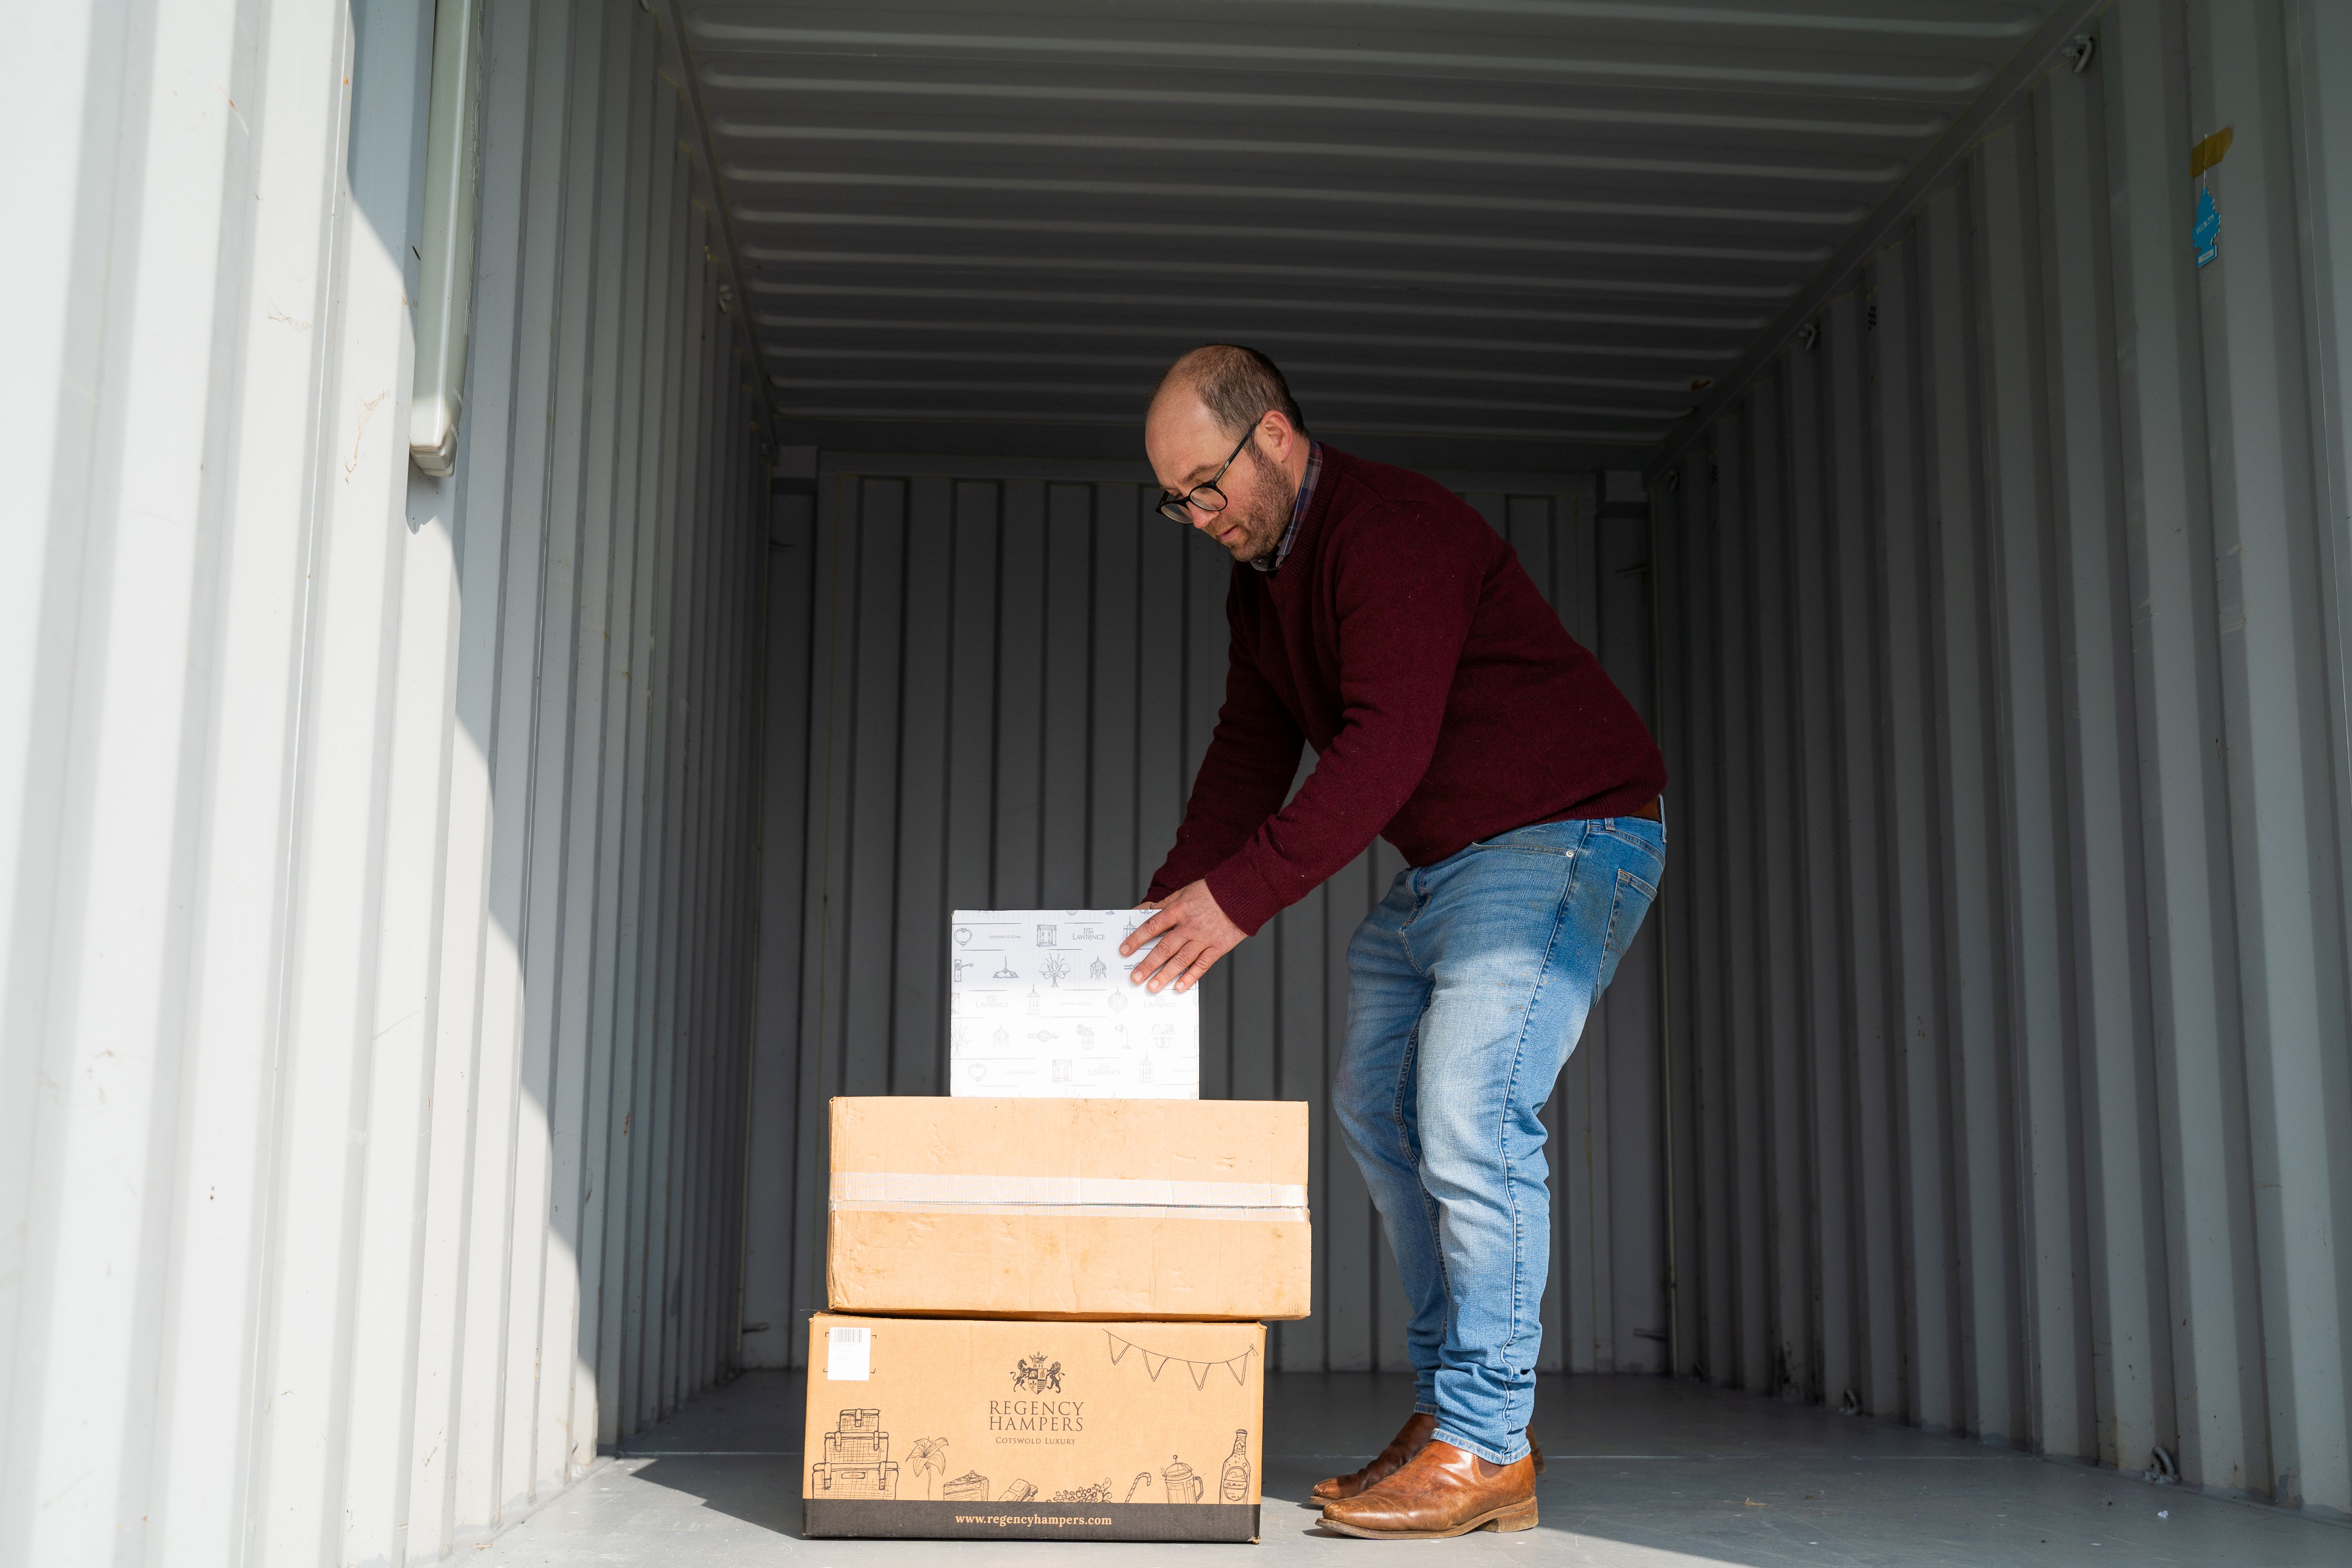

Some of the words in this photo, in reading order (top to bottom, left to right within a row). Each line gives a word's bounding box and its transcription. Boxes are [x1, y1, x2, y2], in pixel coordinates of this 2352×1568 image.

[989, 1401, 1084, 1416] REGENCY
[989, 1416, 1083, 1432] HAMPERS
[955, 1514, 1112, 1527] www.regencyhampers.com
